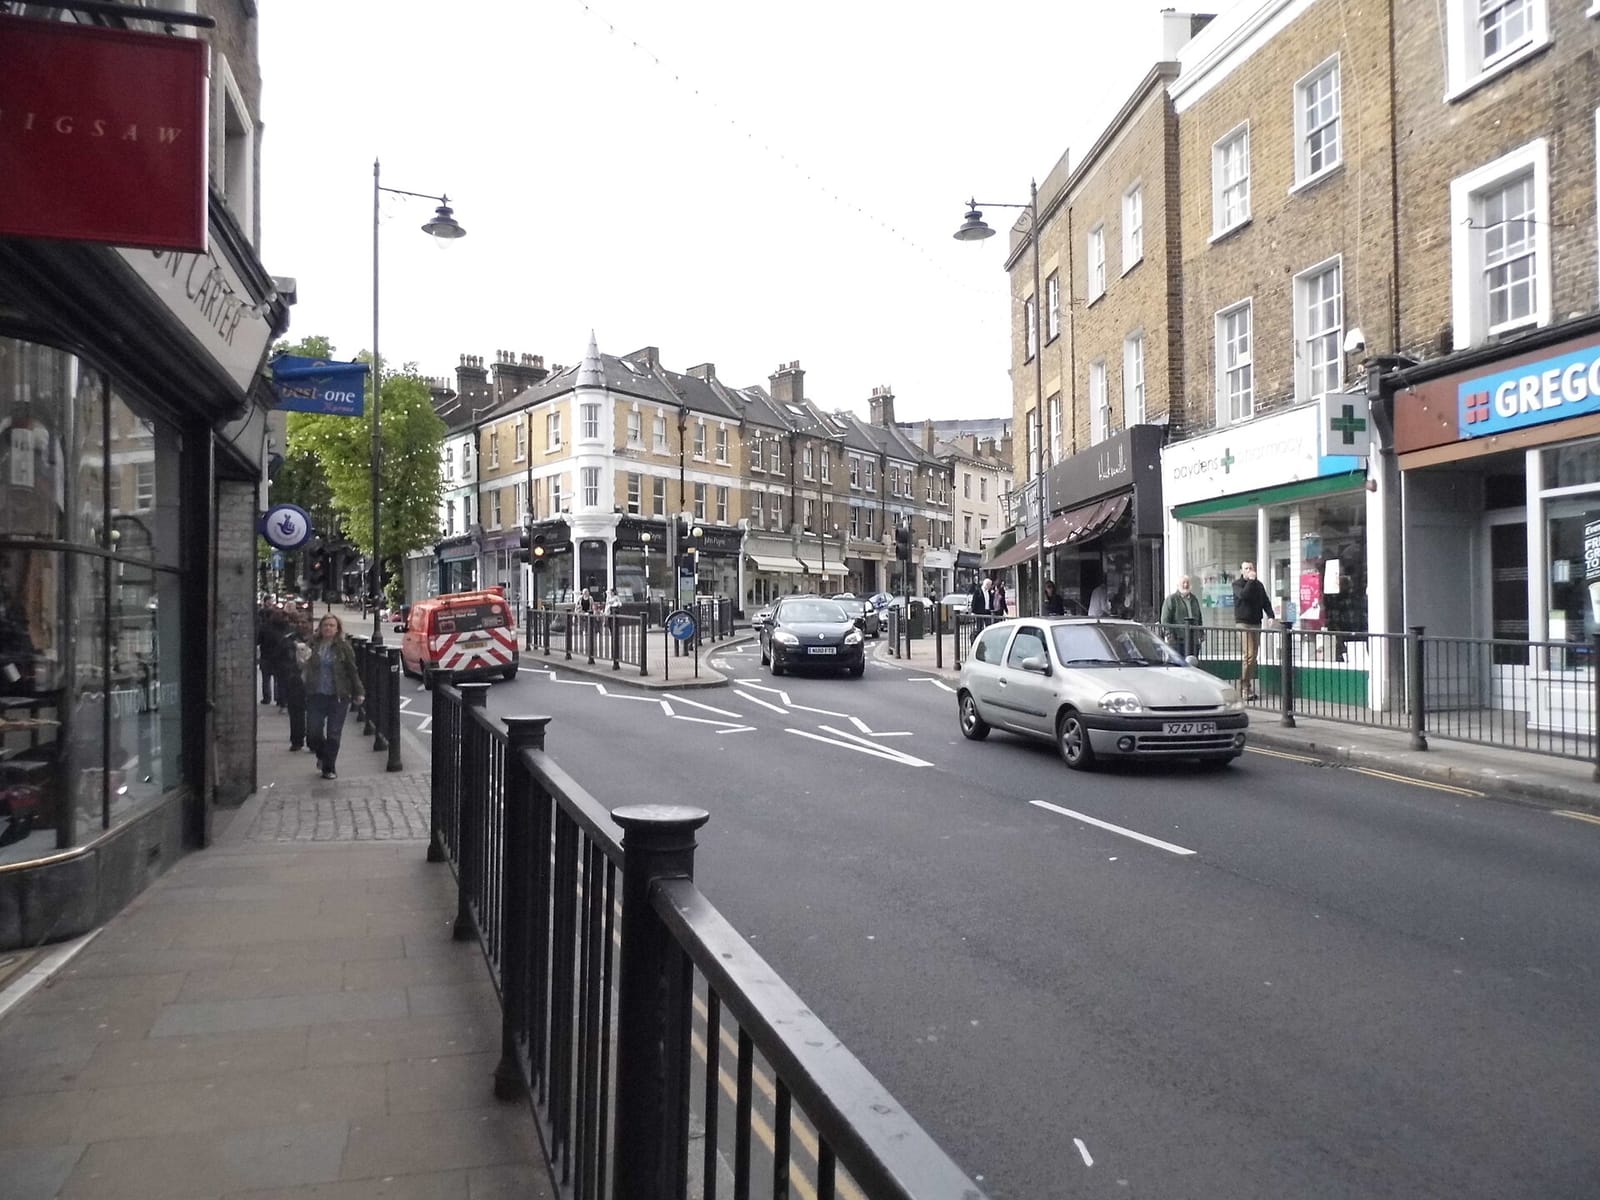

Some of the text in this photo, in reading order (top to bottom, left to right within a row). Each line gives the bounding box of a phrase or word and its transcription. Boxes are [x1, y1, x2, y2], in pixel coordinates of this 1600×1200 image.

[0, 110, 182, 144] IGSAW
[1173, 455, 1219, 480] paydens
[1585, 558, 1599, 569] TO
[1168, 723, 1194, 734] X747
